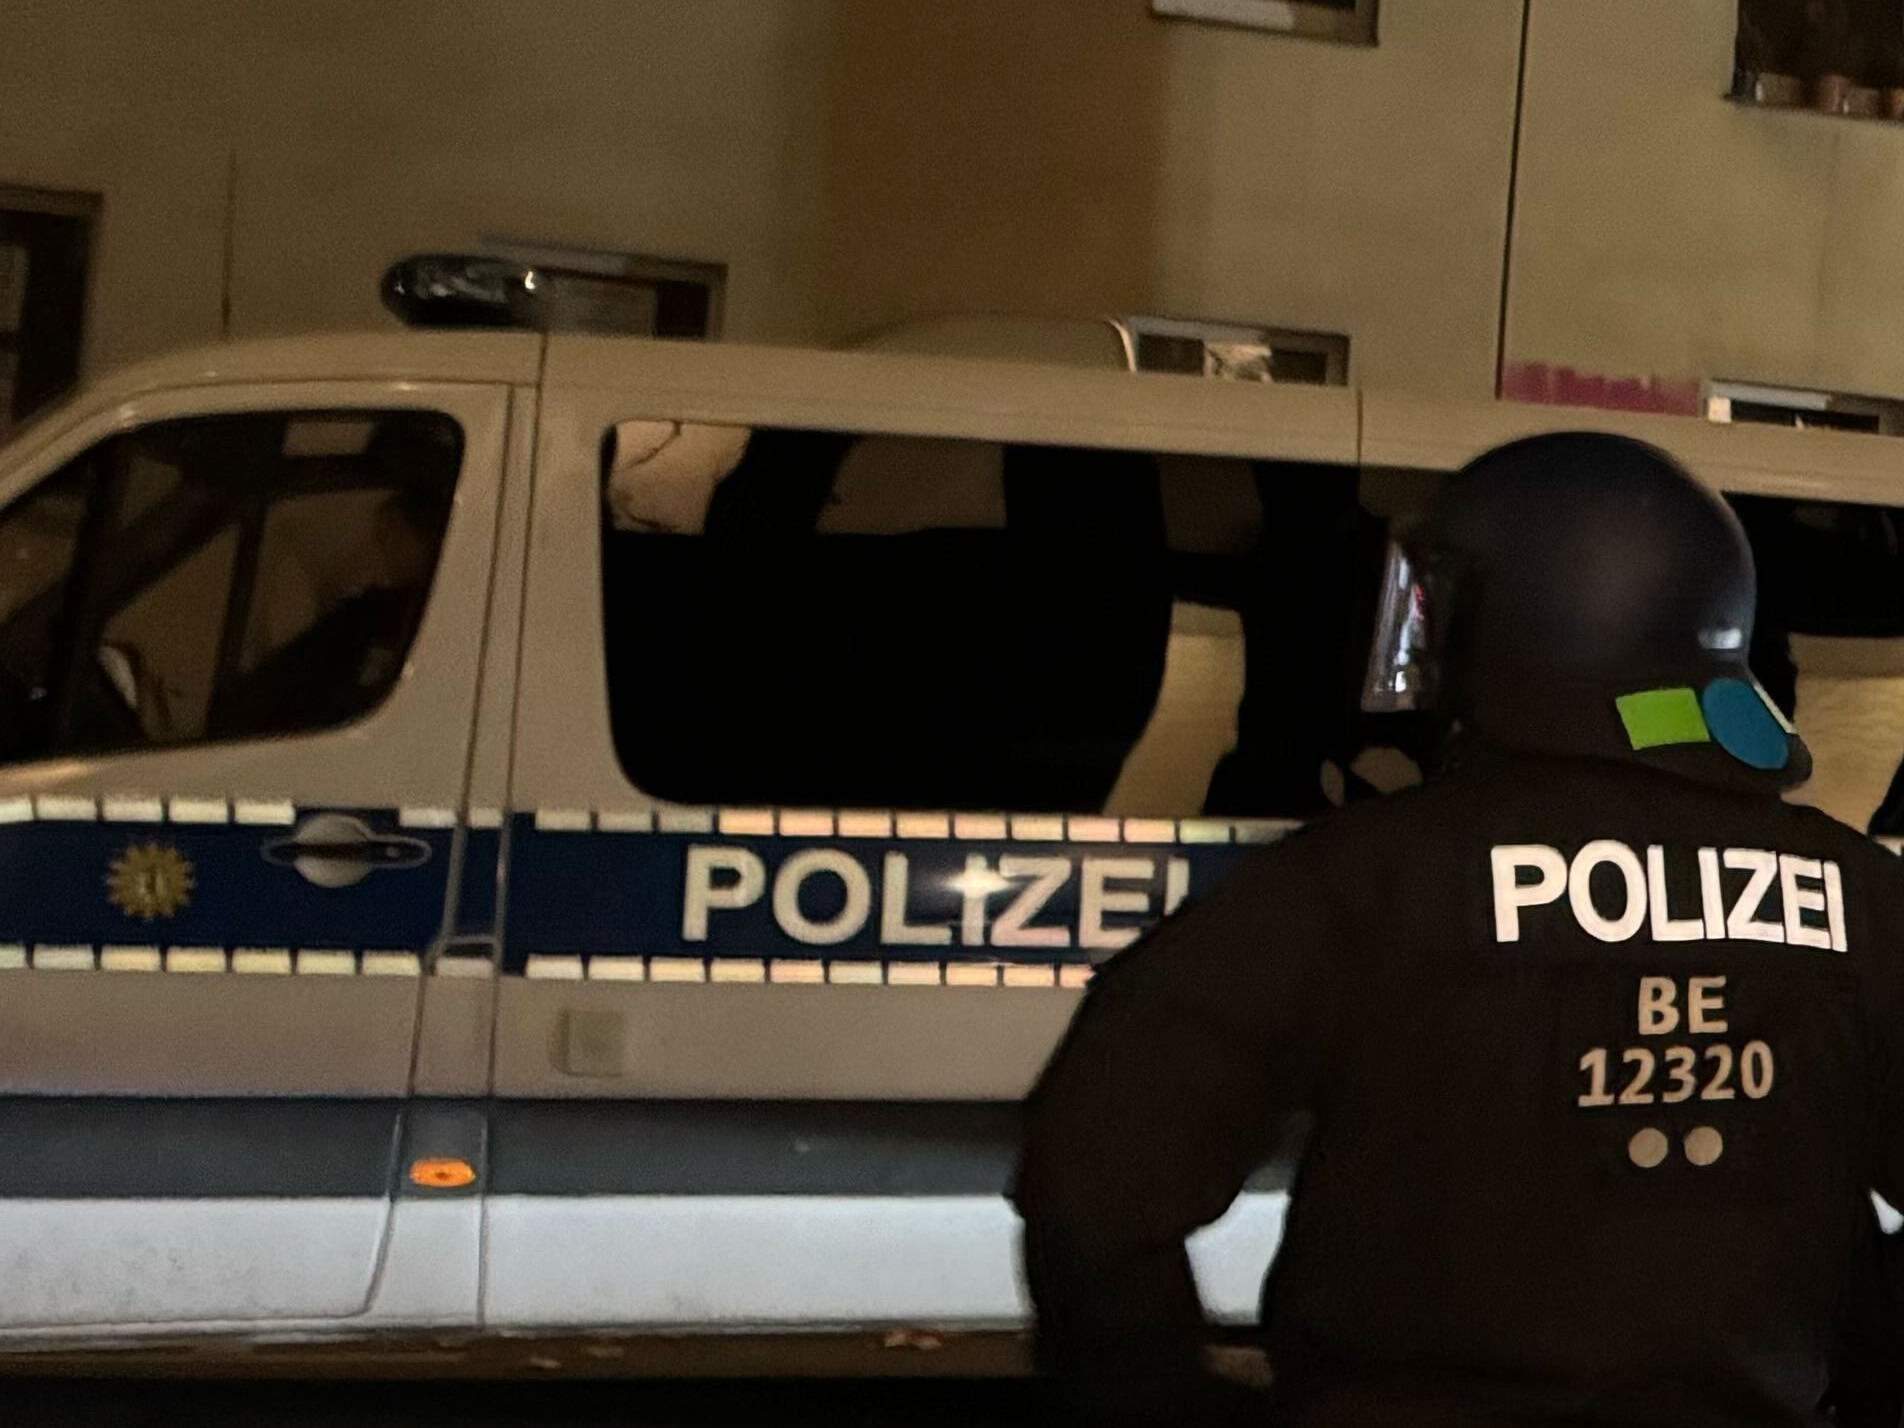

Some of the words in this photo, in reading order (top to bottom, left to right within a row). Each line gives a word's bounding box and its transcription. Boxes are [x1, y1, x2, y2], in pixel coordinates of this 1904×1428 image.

[681, 844, 1190, 948] POLIZEI
[1490, 839, 1848, 952] POLIZEI
[1638, 975, 1729, 1035] BE
[1577, 1040, 1775, 1107] 12320
